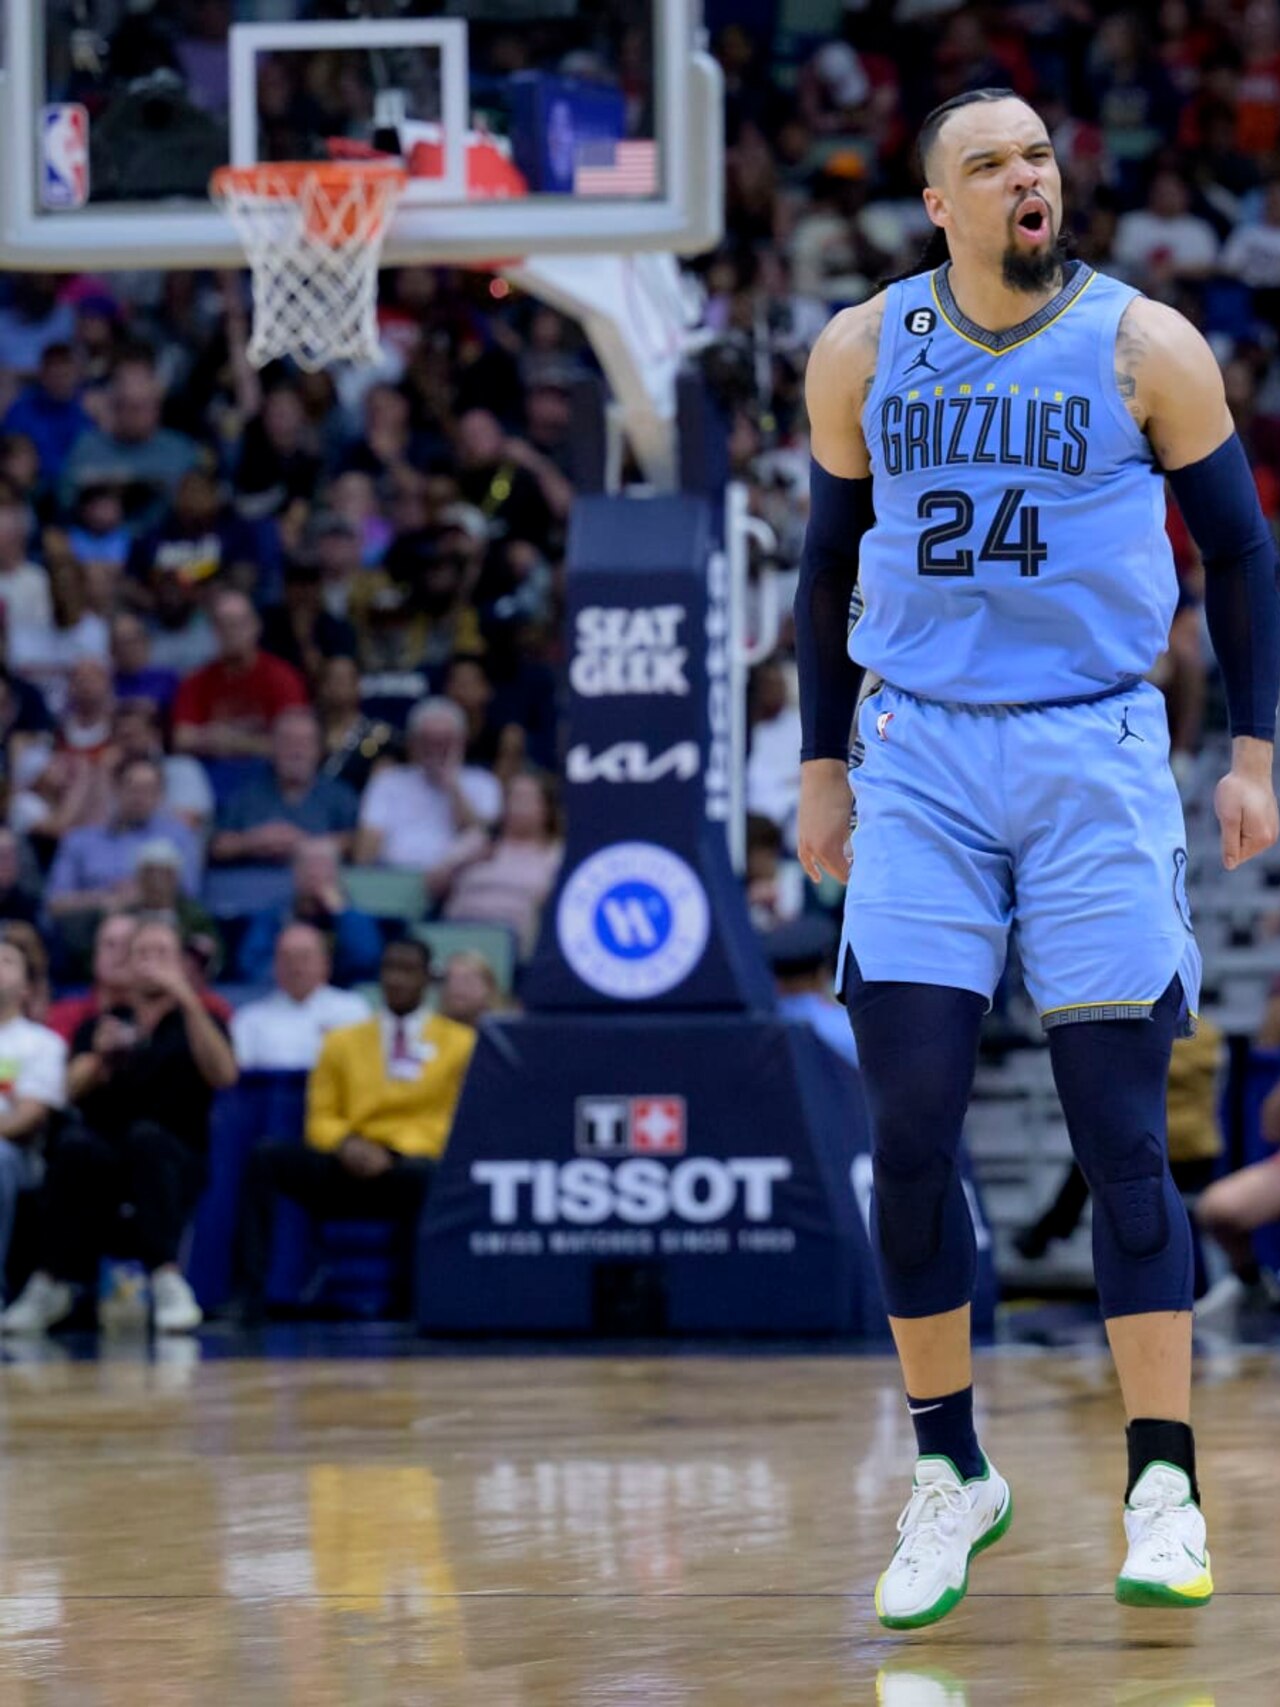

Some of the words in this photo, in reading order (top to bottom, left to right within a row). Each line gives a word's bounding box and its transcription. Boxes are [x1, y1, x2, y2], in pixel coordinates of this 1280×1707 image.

[911, 311, 931, 333] 6
[907, 383, 1064, 401] MEMPHIS
[881, 395, 1090, 477] GRIZZLIES
[917, 488, 1048, 577] 24
[576, 605, 685, 648] SEAT
[570, 647, 689, 696] GEEK
[471, 1157, 791, 1224] TISSOT
